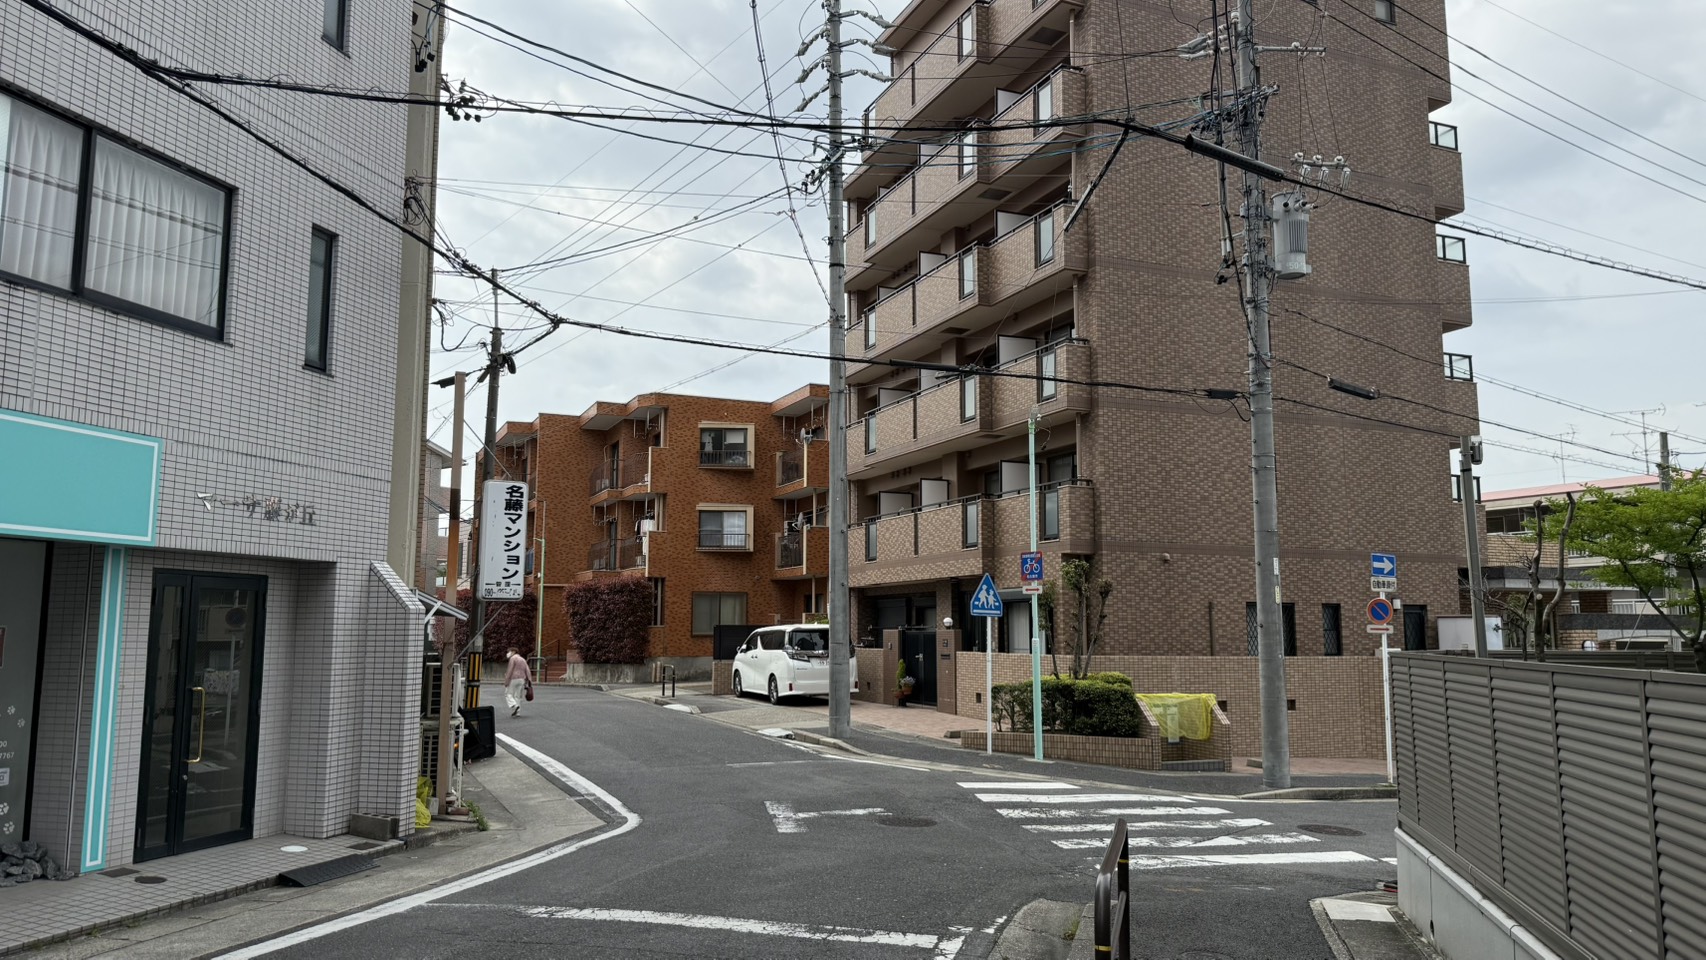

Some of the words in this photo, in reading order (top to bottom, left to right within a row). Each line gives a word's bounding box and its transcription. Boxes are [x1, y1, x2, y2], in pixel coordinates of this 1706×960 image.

[502, 485, 524, 579] 名藤マンション
